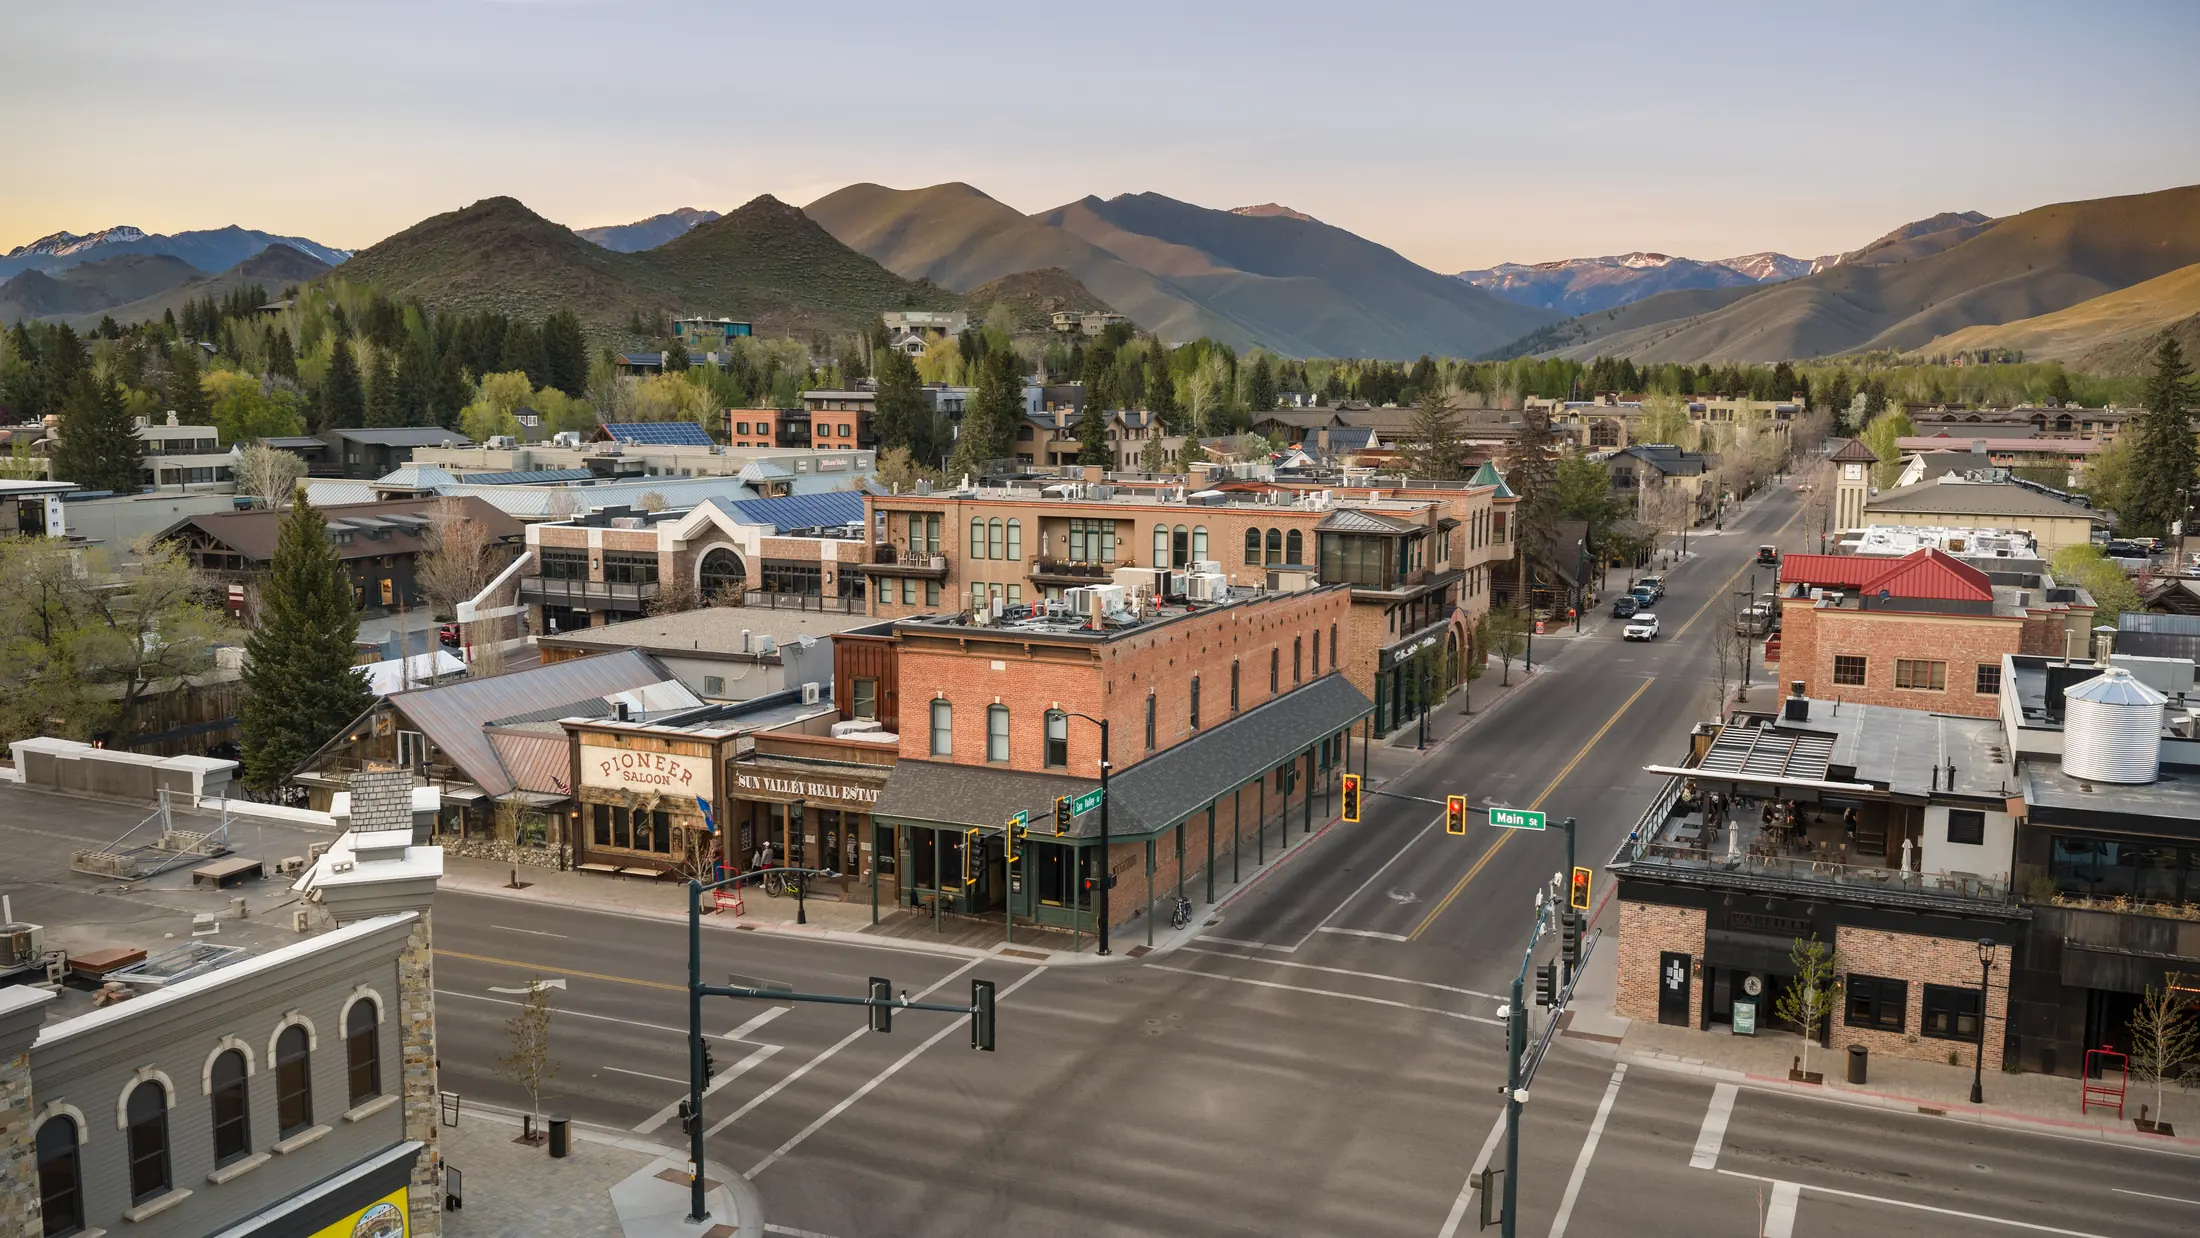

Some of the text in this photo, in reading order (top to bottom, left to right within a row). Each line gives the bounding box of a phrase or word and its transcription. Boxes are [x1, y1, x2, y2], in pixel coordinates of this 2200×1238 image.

[600, 753, 693, 787] PIONEER
[623, 770, 671, 786] SALOON
[738, 774, 882, 803] SUN VALLEY REAL ESTAT
[1084, 797, 1095, 808] Valley
[1496, 812, 1538, 826] Main St
